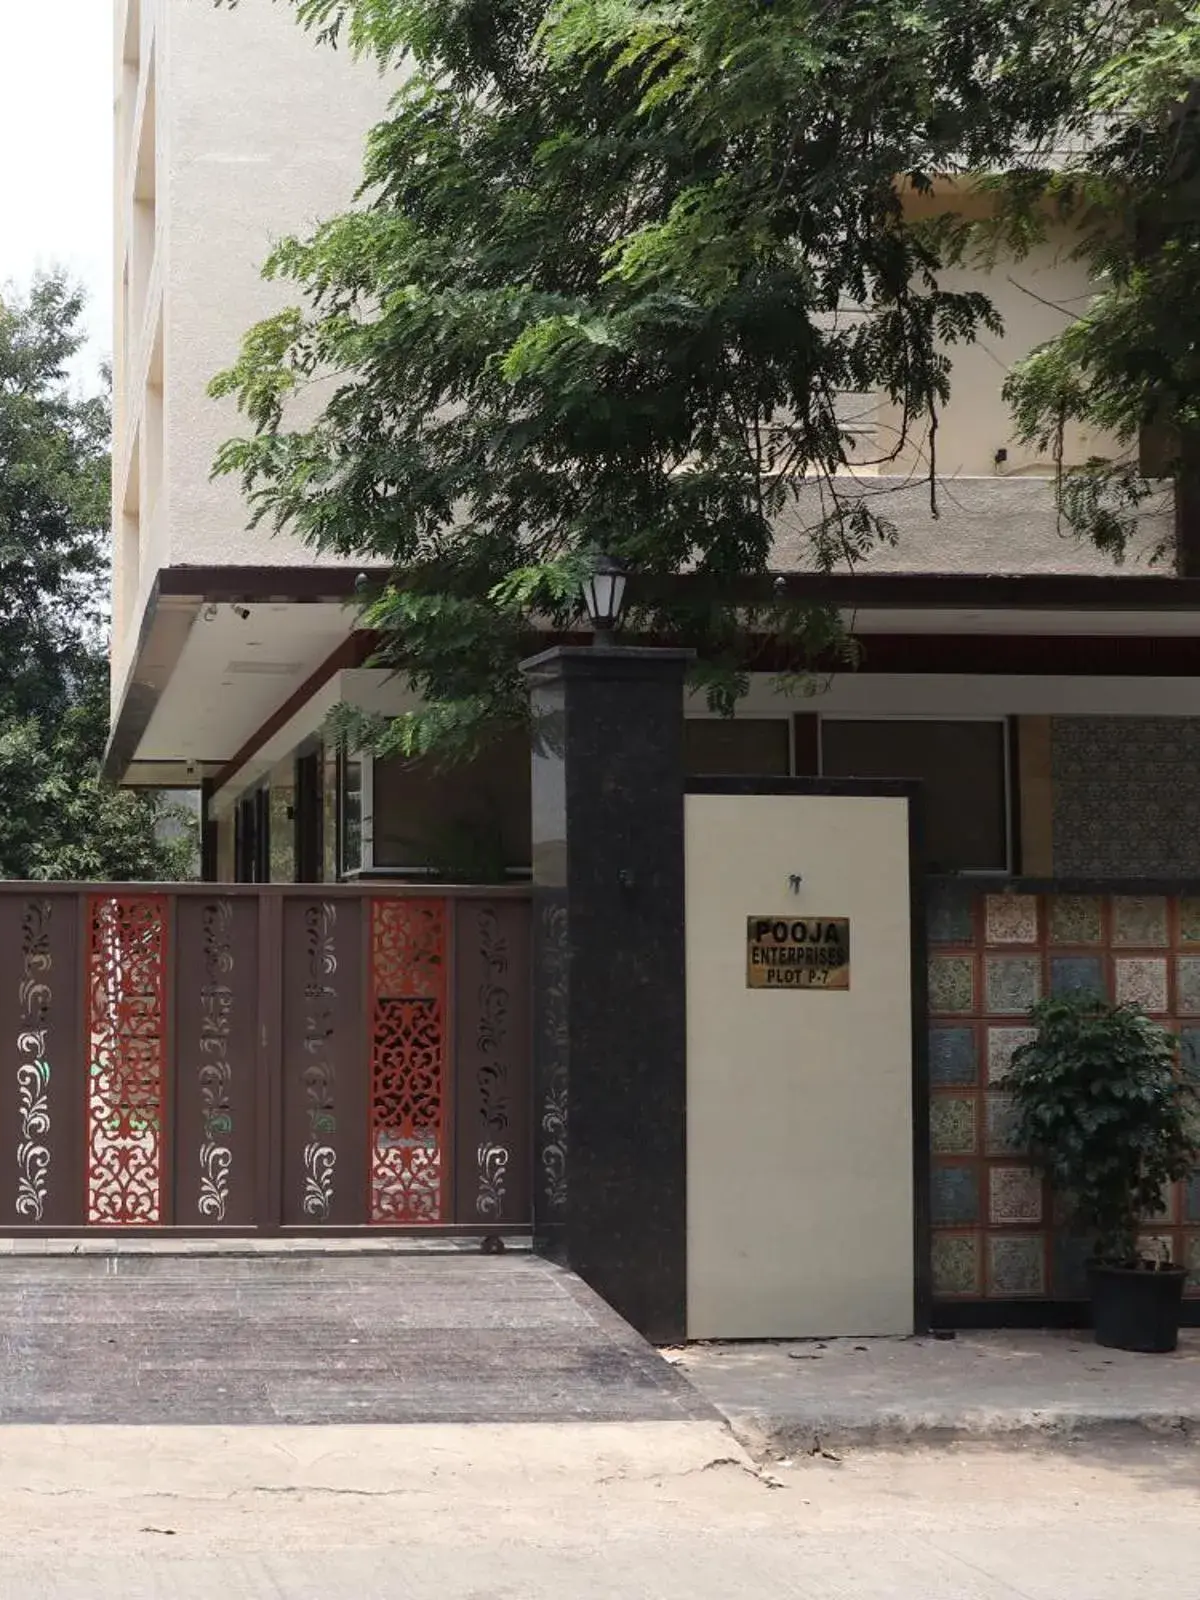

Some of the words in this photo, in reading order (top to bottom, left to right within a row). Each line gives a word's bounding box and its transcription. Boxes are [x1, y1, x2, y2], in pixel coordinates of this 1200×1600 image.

[756, 921, 840, 943] POOJA
[751, 946, 846, 966] ENTERPRISES
[767, 969, 803, 983] PLOT
[809, 969, 829, 984] P-7
